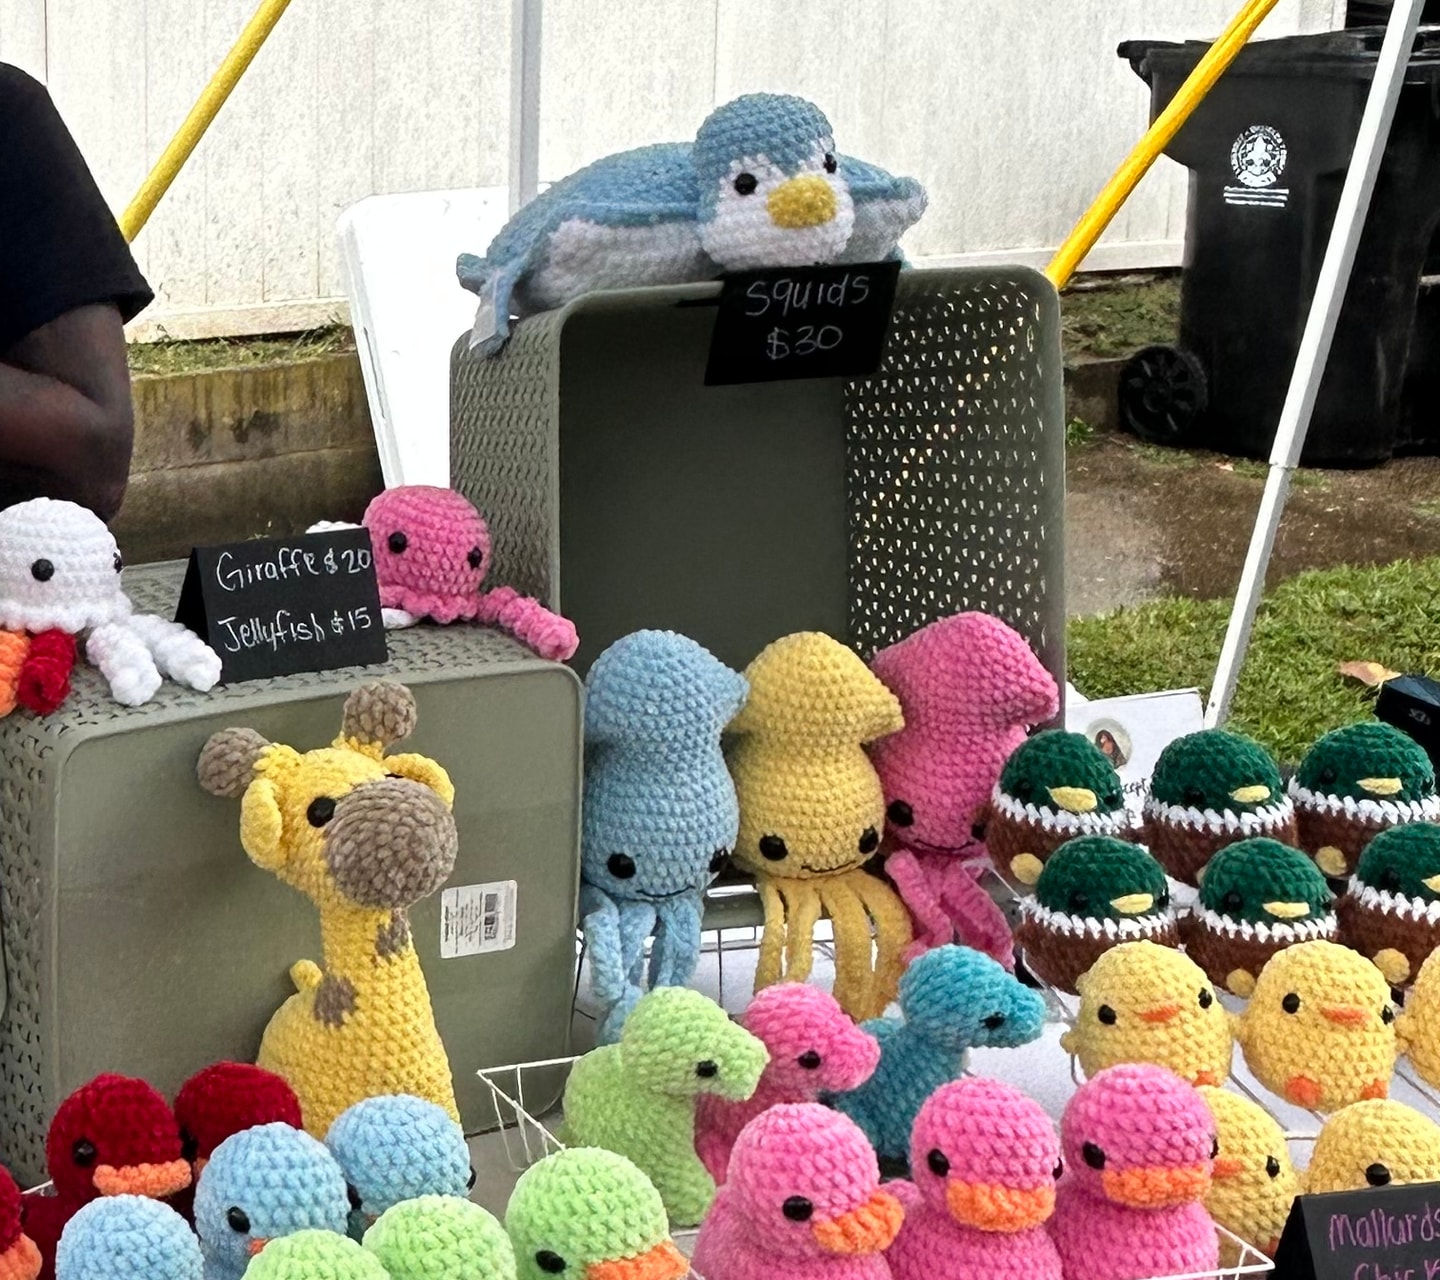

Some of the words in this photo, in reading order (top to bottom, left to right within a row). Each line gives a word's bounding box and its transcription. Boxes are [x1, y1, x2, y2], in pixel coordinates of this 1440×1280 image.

[766, 324, 843, 360] $30
[216, 547, 320, 592] Giraffe
[323, 547, 372, 574] $20
[217, 609, 326, 652] Jellyfish
[330, 606, 372, 635] $15
